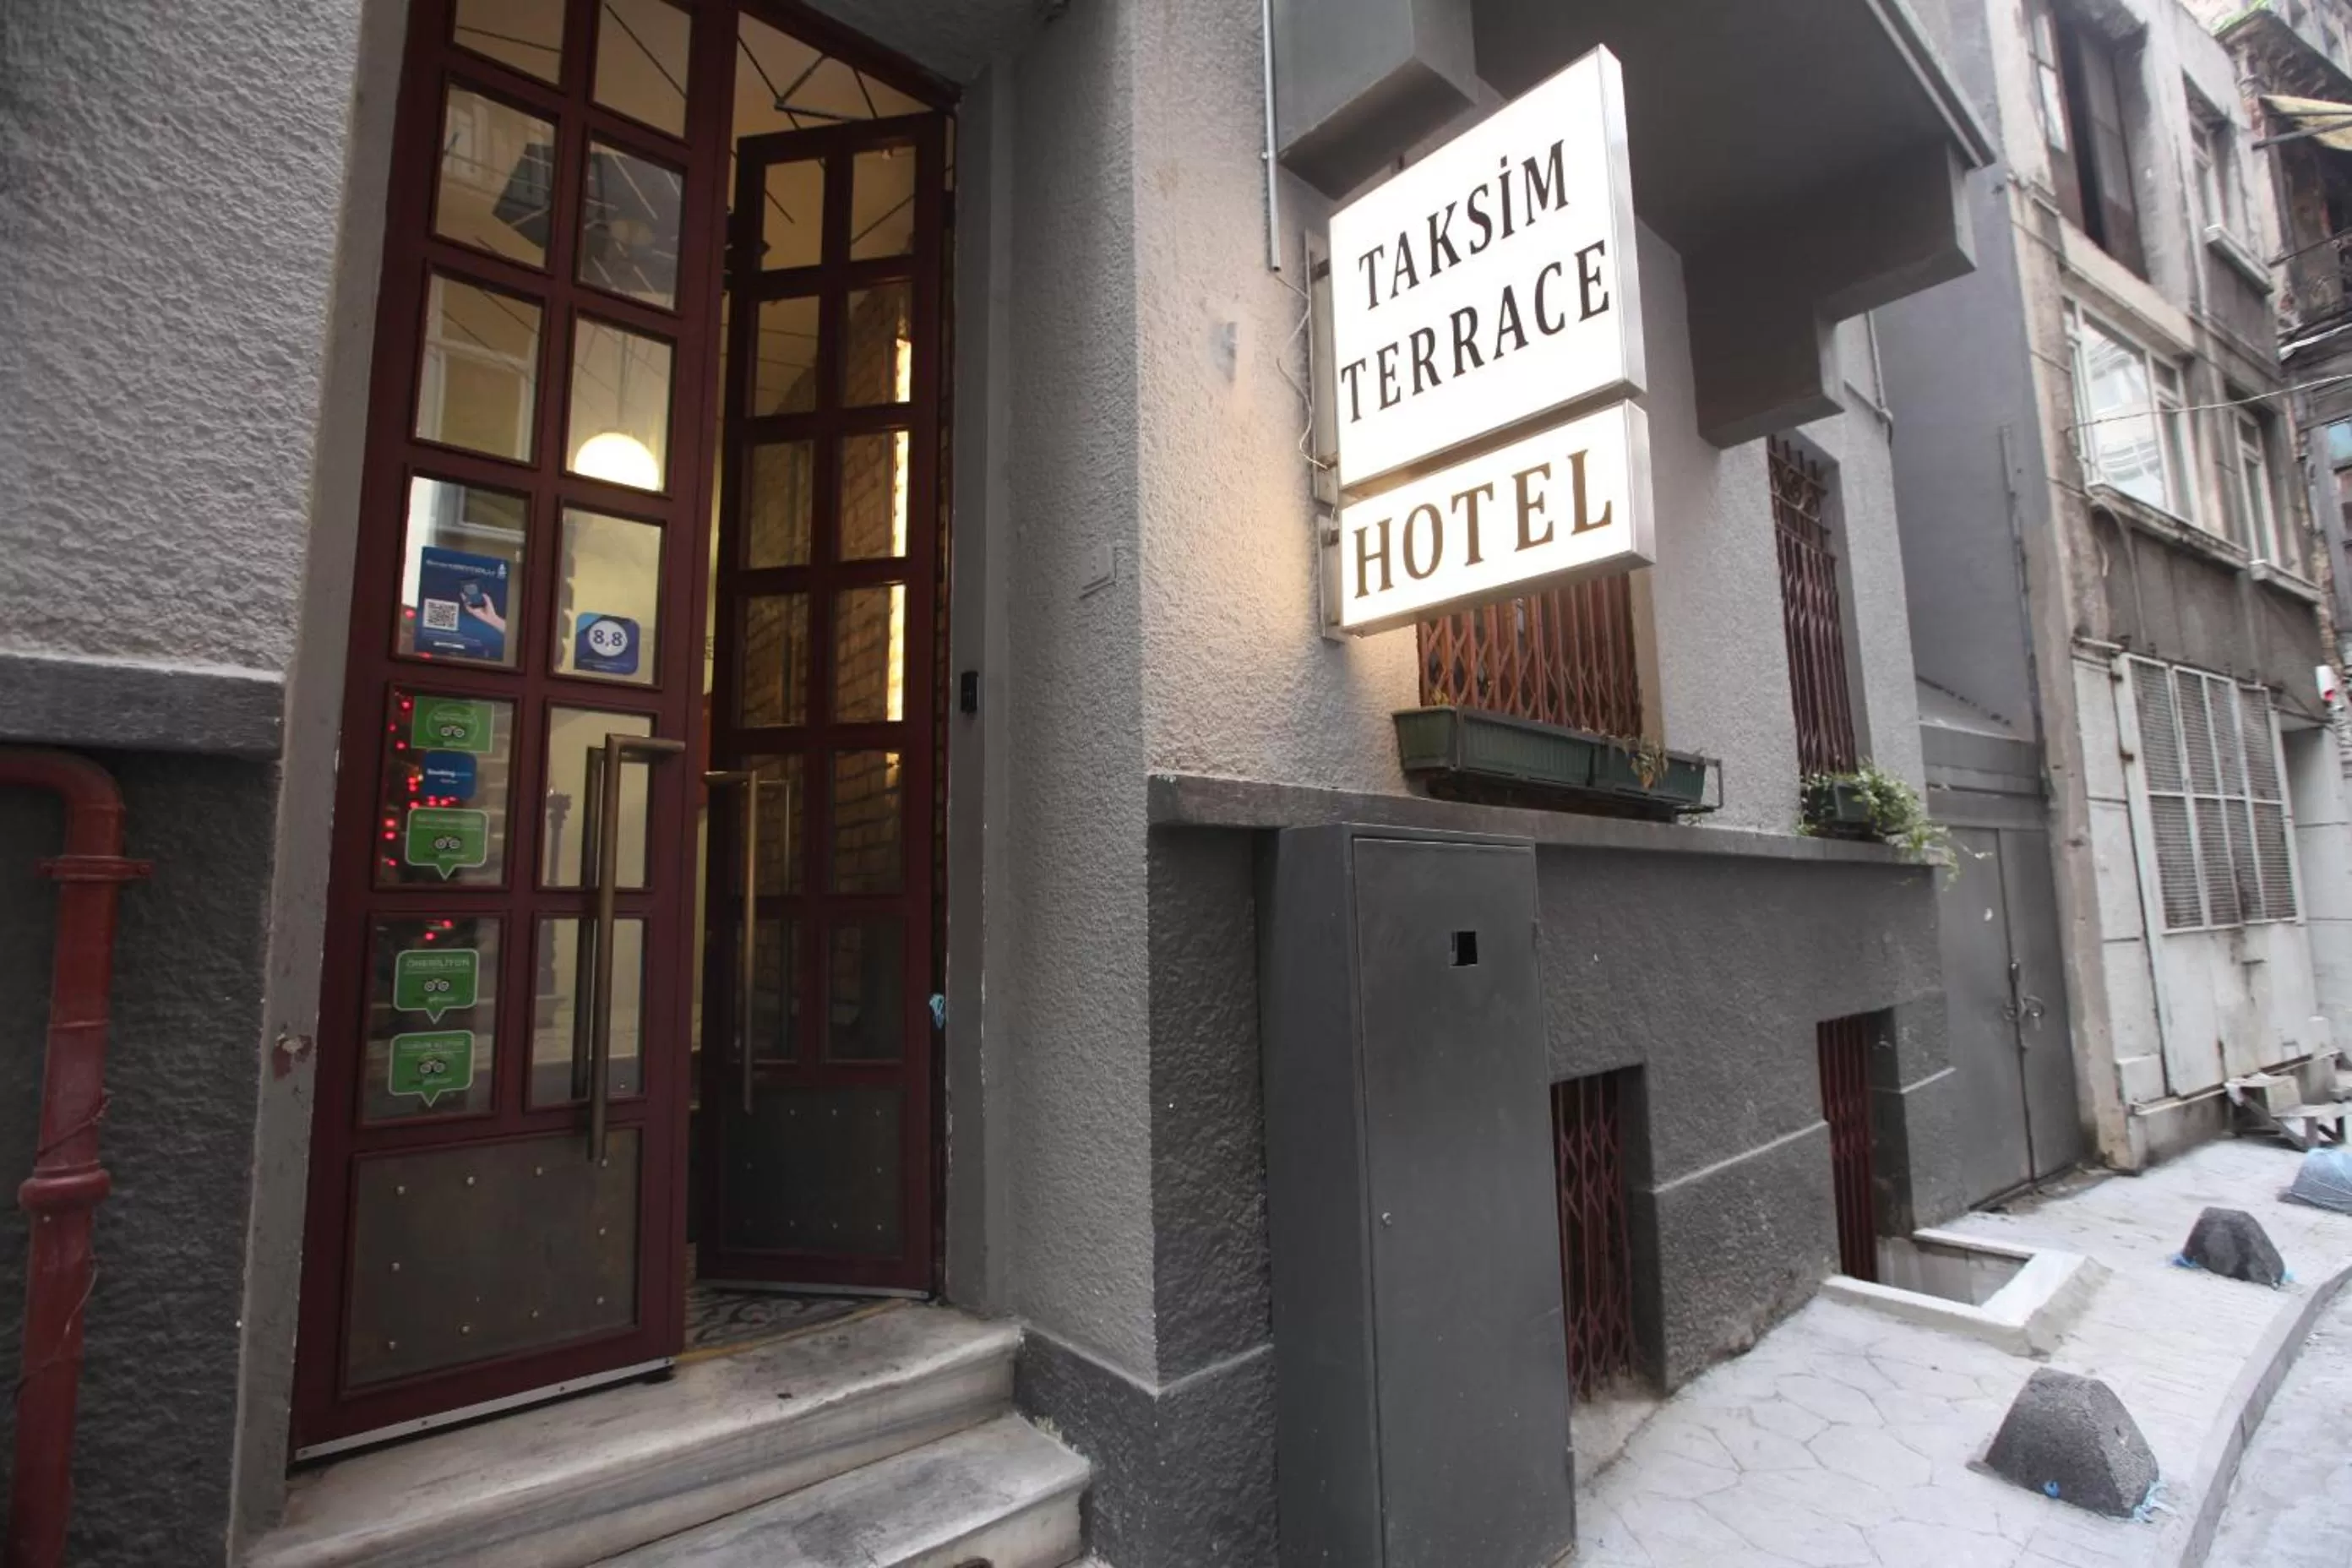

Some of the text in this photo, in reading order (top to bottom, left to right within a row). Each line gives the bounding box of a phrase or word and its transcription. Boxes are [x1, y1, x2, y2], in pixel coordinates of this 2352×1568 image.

[1358, 139, 1569, 310] TAKSİM
[1341, 239, 1609, 423] TERRACE
[1353, 449, 1612, 599] HOTEL
[593, 629, 623, 647] 8.8
